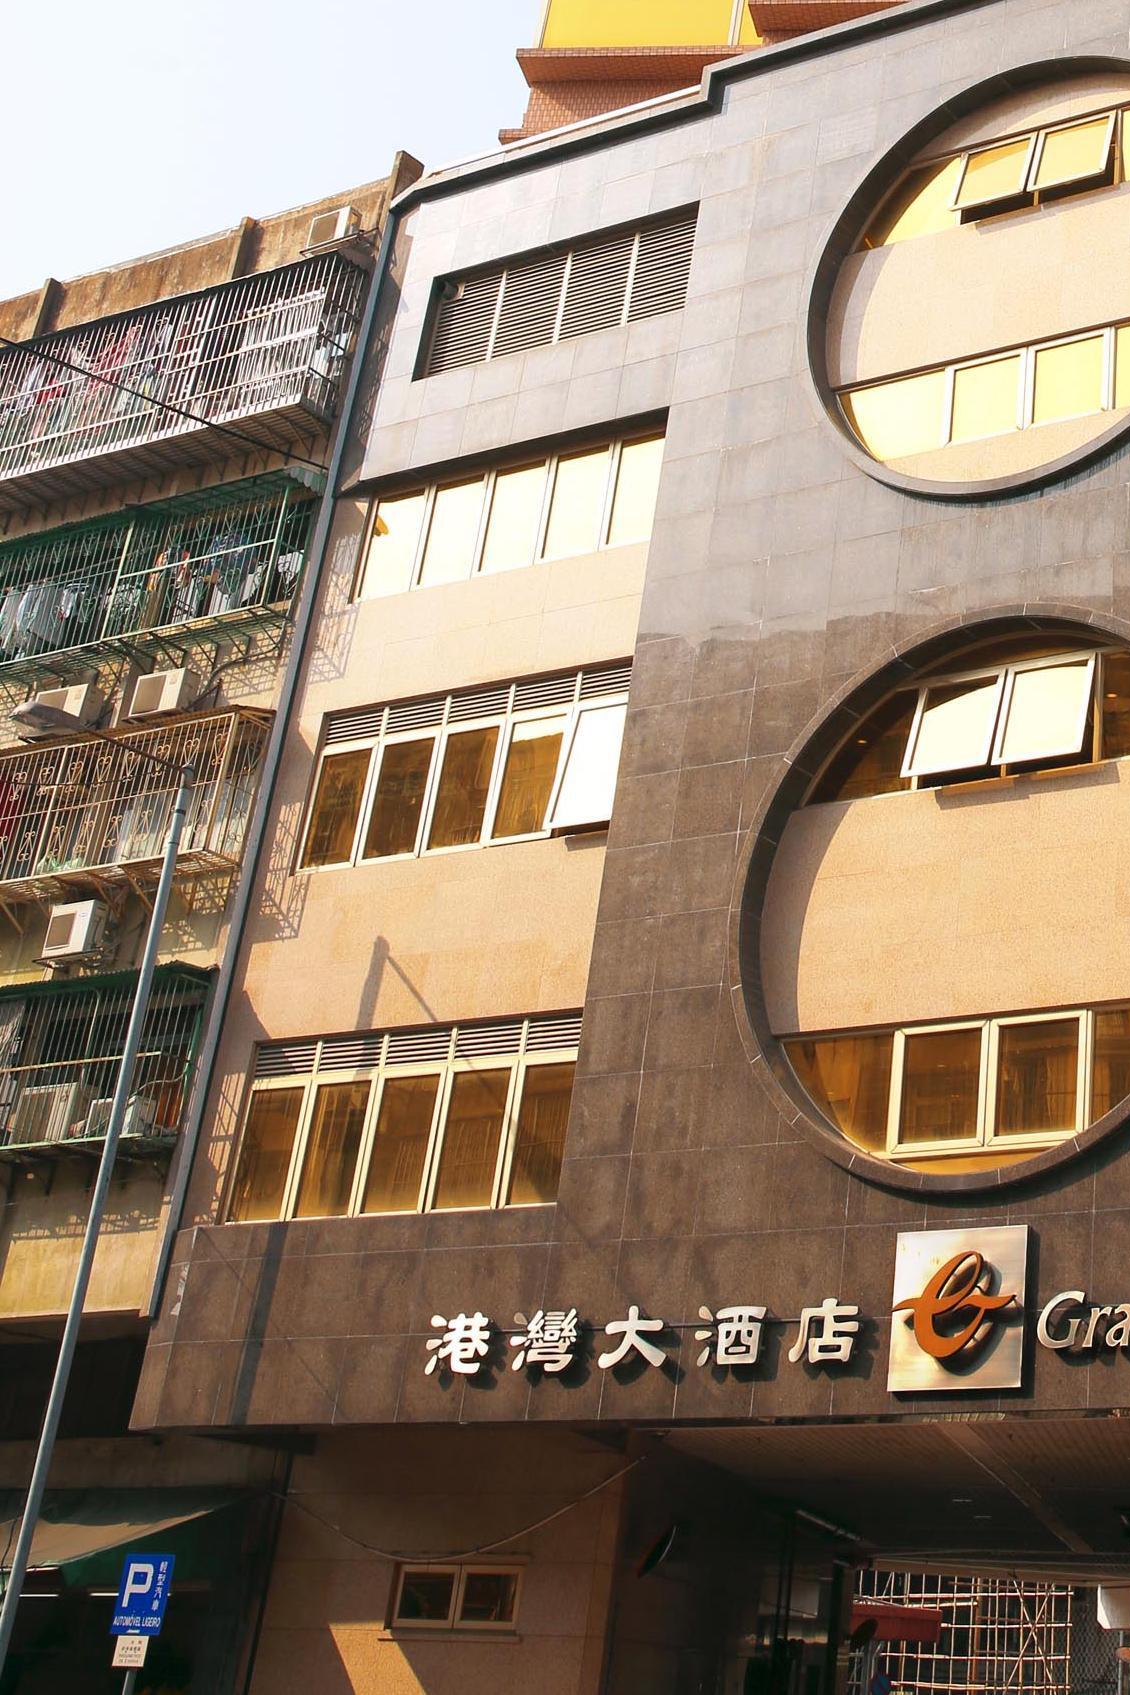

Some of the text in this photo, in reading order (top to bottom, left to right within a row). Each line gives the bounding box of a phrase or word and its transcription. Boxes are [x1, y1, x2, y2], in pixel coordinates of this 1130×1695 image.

[424, 1298, 861, 1376] 港灣大酒店
[121, 1563, 154, 1607] P
